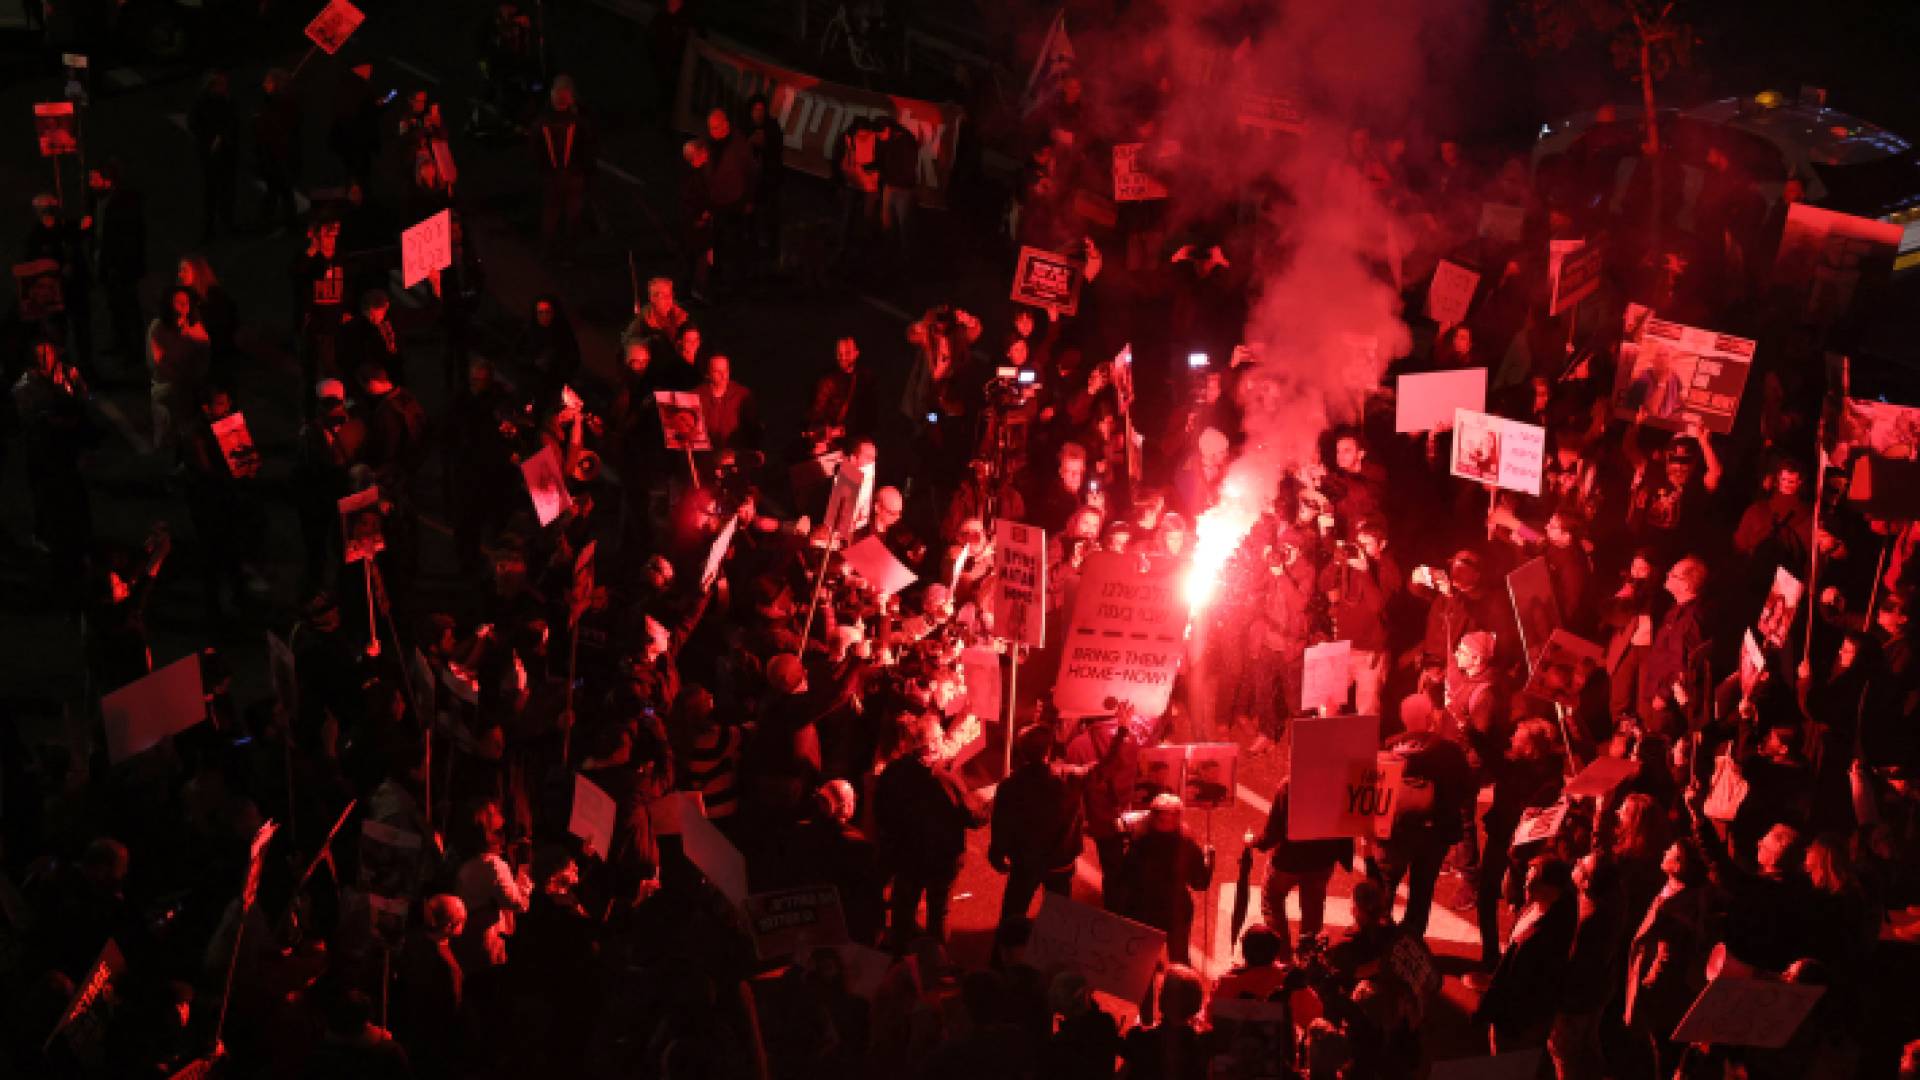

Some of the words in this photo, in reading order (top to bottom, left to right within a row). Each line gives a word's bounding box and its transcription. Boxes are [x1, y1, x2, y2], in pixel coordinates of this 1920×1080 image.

[1072, 647, 1121, 664] BRING
[1124, 650, 1168, 668] THEM
[1348, 784, 1392, 816] YOU
